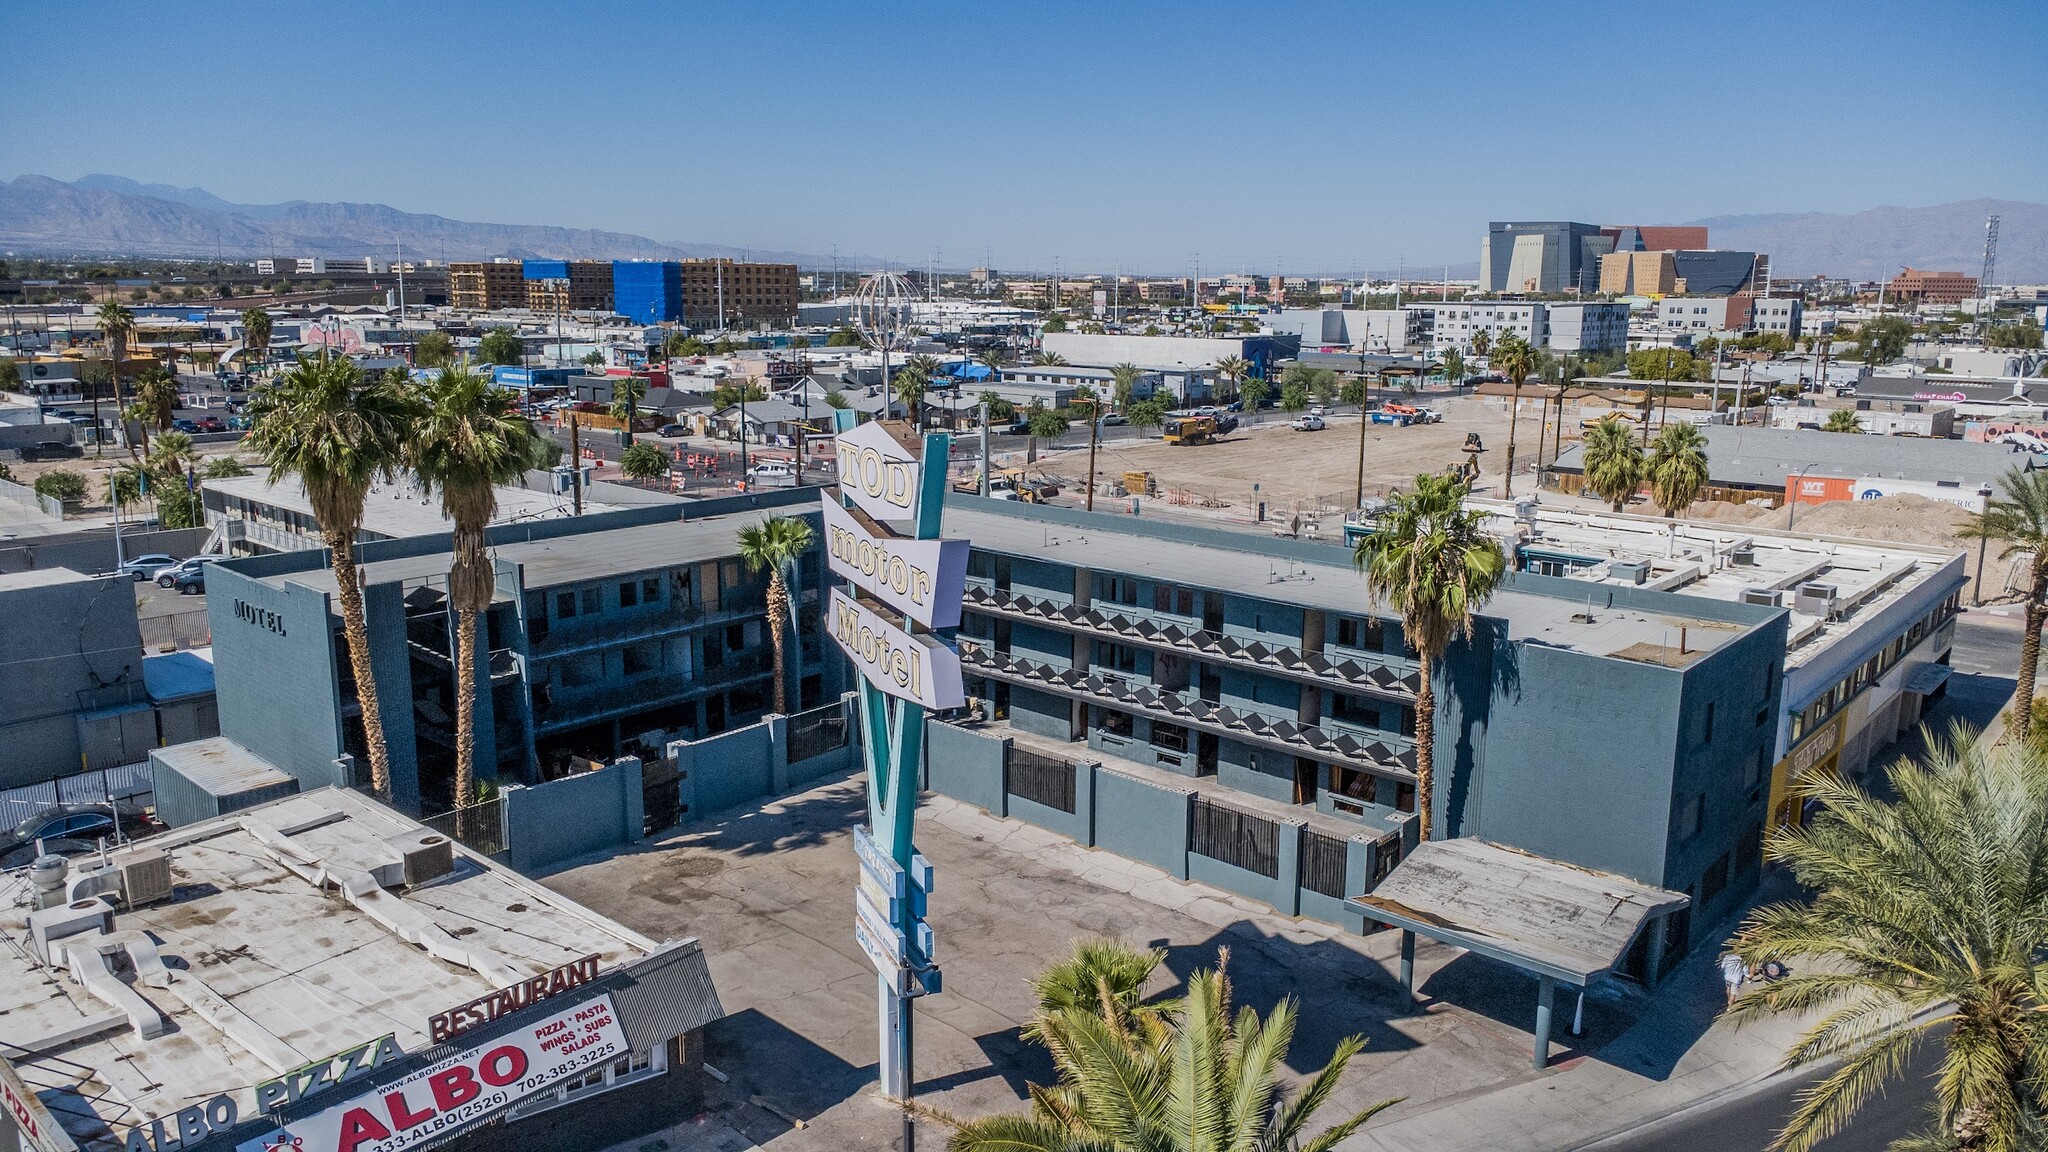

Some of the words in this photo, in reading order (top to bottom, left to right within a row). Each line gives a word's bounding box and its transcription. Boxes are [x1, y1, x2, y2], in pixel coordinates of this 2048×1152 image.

[837, 440, 913, 509] TOD
[1803, 482, 1825, 491] WT
[830, 523, 931, 607] motor
[234, 598, 287, 638] MOTEL
[835, 598, 924, 700] Motel
[1794, 723, 1836, 779] TATTOO
[429, 953, 602, 1045] RESTAURANT
[534, 1020, 567, 1040] PIZZA
[574, 1003, 608, 1023] PASTA
[540, 1031, 576, 1052] WINGS
[584, 1015, 612, 1033] SUBS
[561, 1032, 602, 1056] SALADS
[126, 1093, 239, 1152] ALBO
[255, 1032, 406, 1115] PIZZA
[376, 1048, 481, 1096] WWW.ALBOPIZZA.NET
[516, 1042, 615, 1093] 702-383-3225
[4, 1083, 40, 1144] PIZZA
[337, 1045, 529, 1152] ALBO
